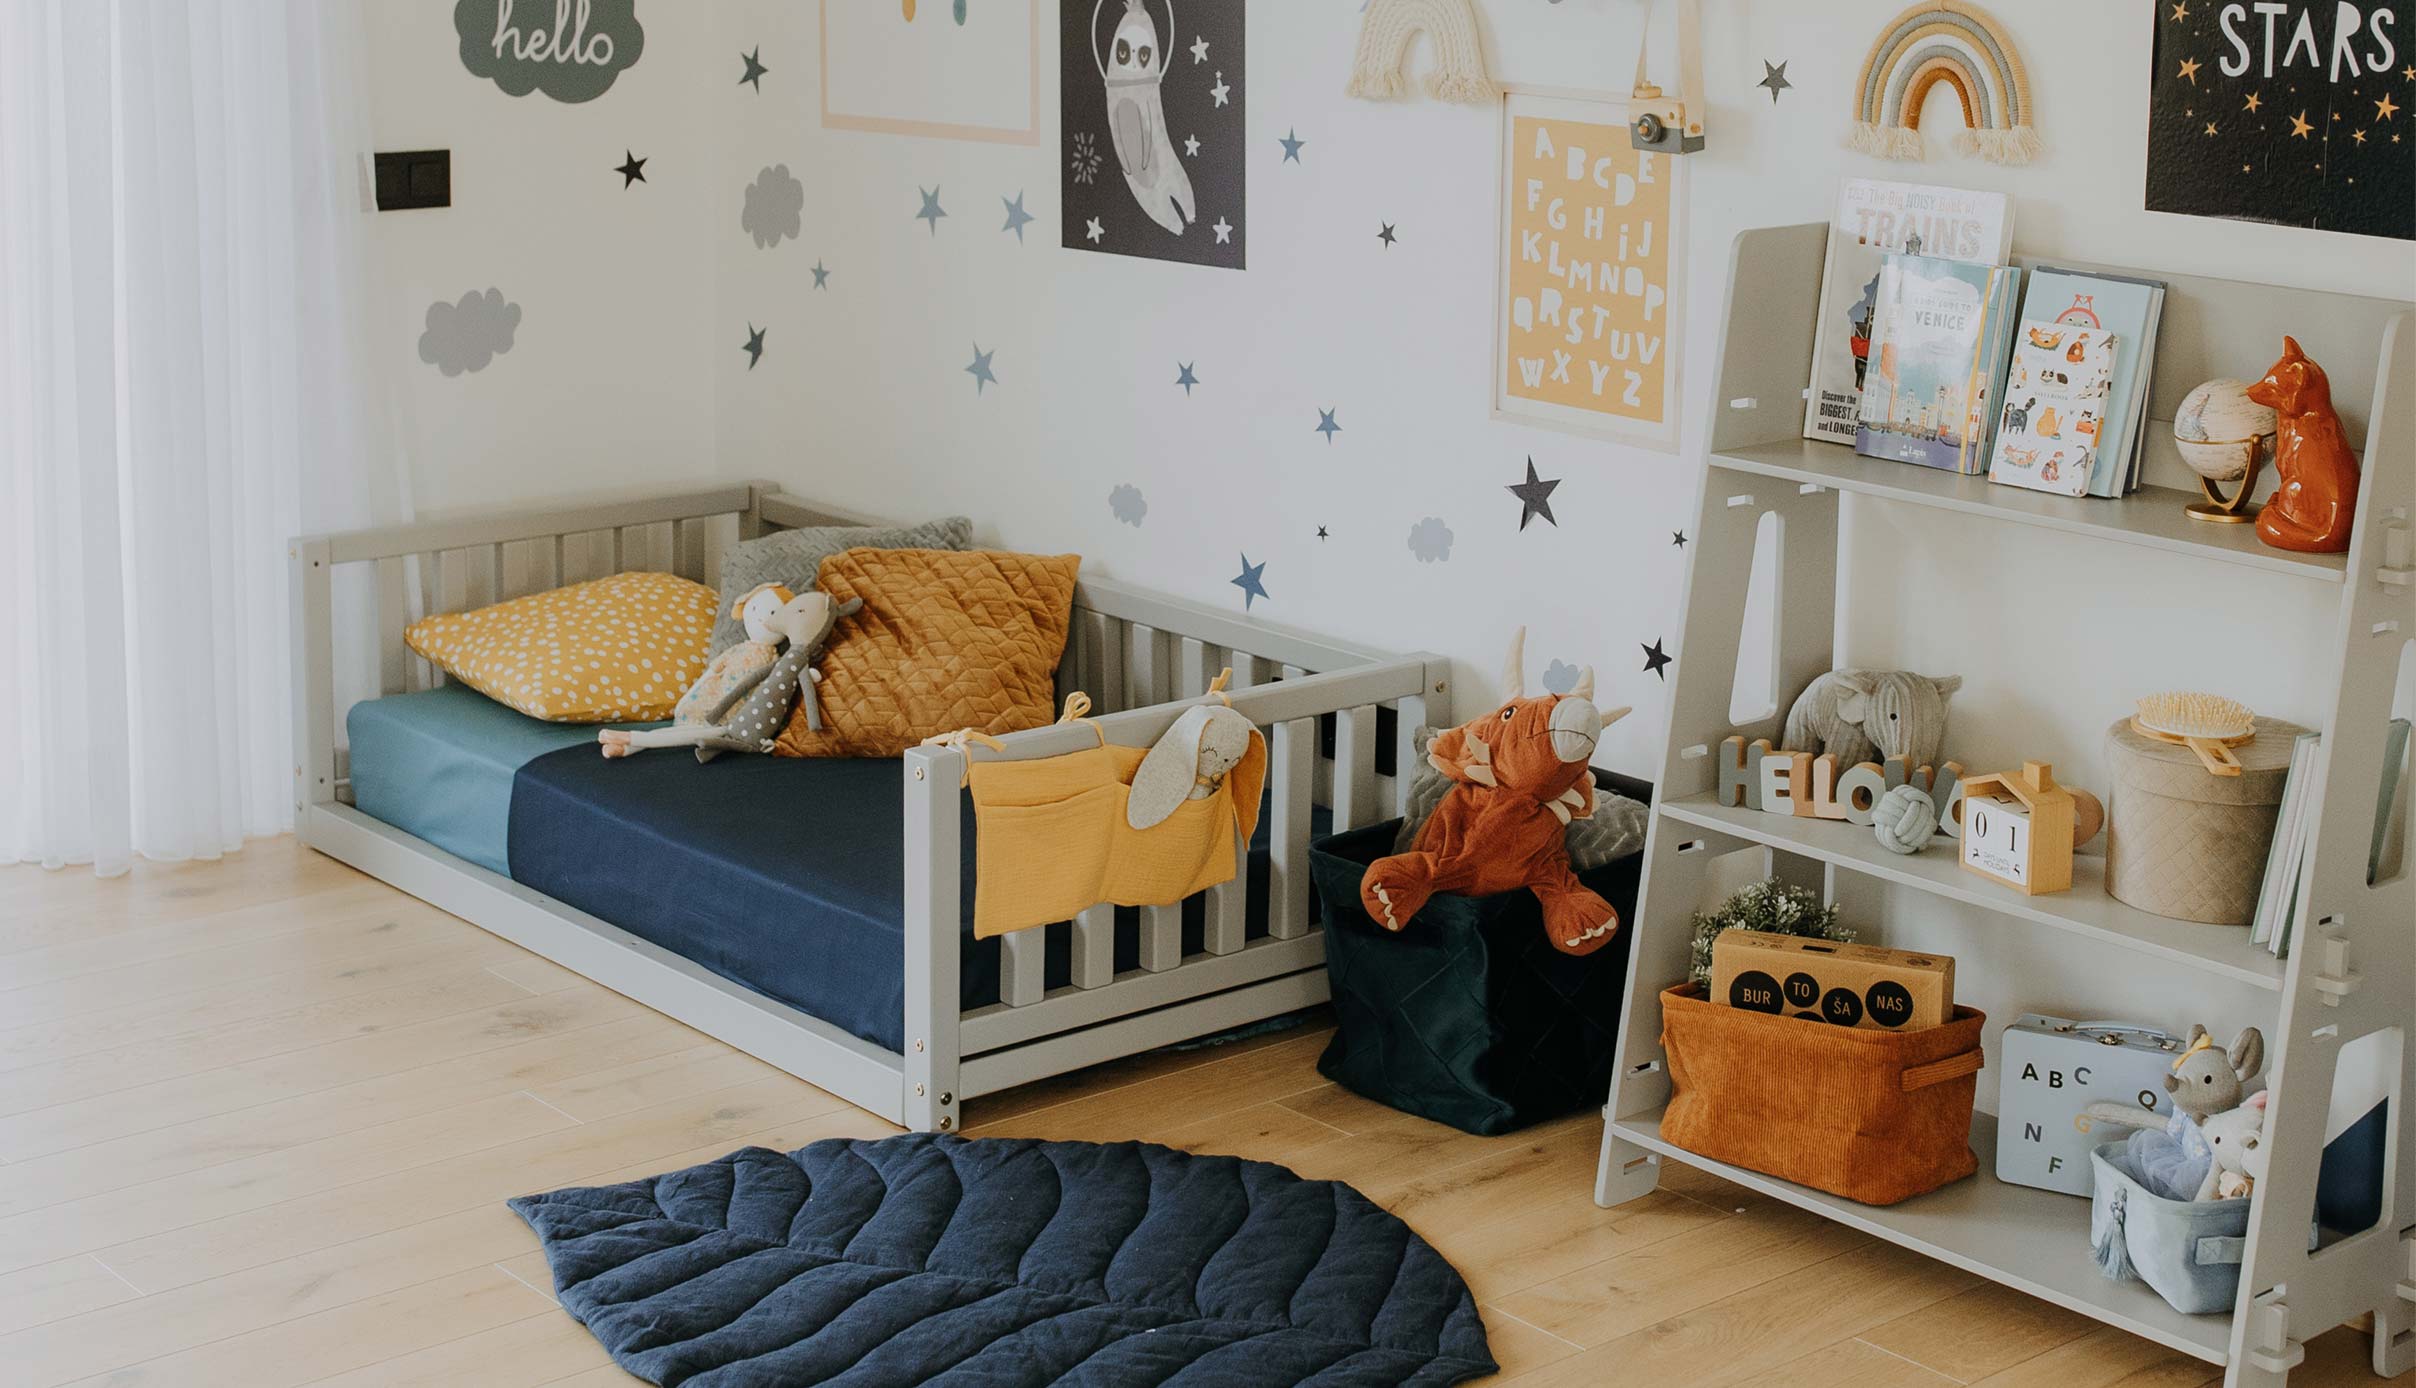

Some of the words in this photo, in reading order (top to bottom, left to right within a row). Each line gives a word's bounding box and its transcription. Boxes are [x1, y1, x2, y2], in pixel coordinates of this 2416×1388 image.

[491, 0, 614, 66] hello
[2219, 1, 2395, 83] STARS
[1869, 188, 1886, 203] The
[1888, 190, 1903, 209] Big
[1906, 191, 1936, 210] NOISY
[1856, 207, 1984, 258] TRAINS
[1915, 311, 1965, 331] VENICE
[1822, 390, 1846, 403] Discover
[1847, 395, 1857, 405] the
[1818, 422, 1828, 432] and
[1719, 735, 1886, 826] HELLO
[1743, 988, 1771, 1005] BUR
[1793, 982, 1810, 998] TO
[1833, 996, 1851, 1016] ŠA
[1876, 995, 1904, 1012] NAS
[2024, 1122, 2042, 1143] N
[2048, 1156, 2063, 1174] F
